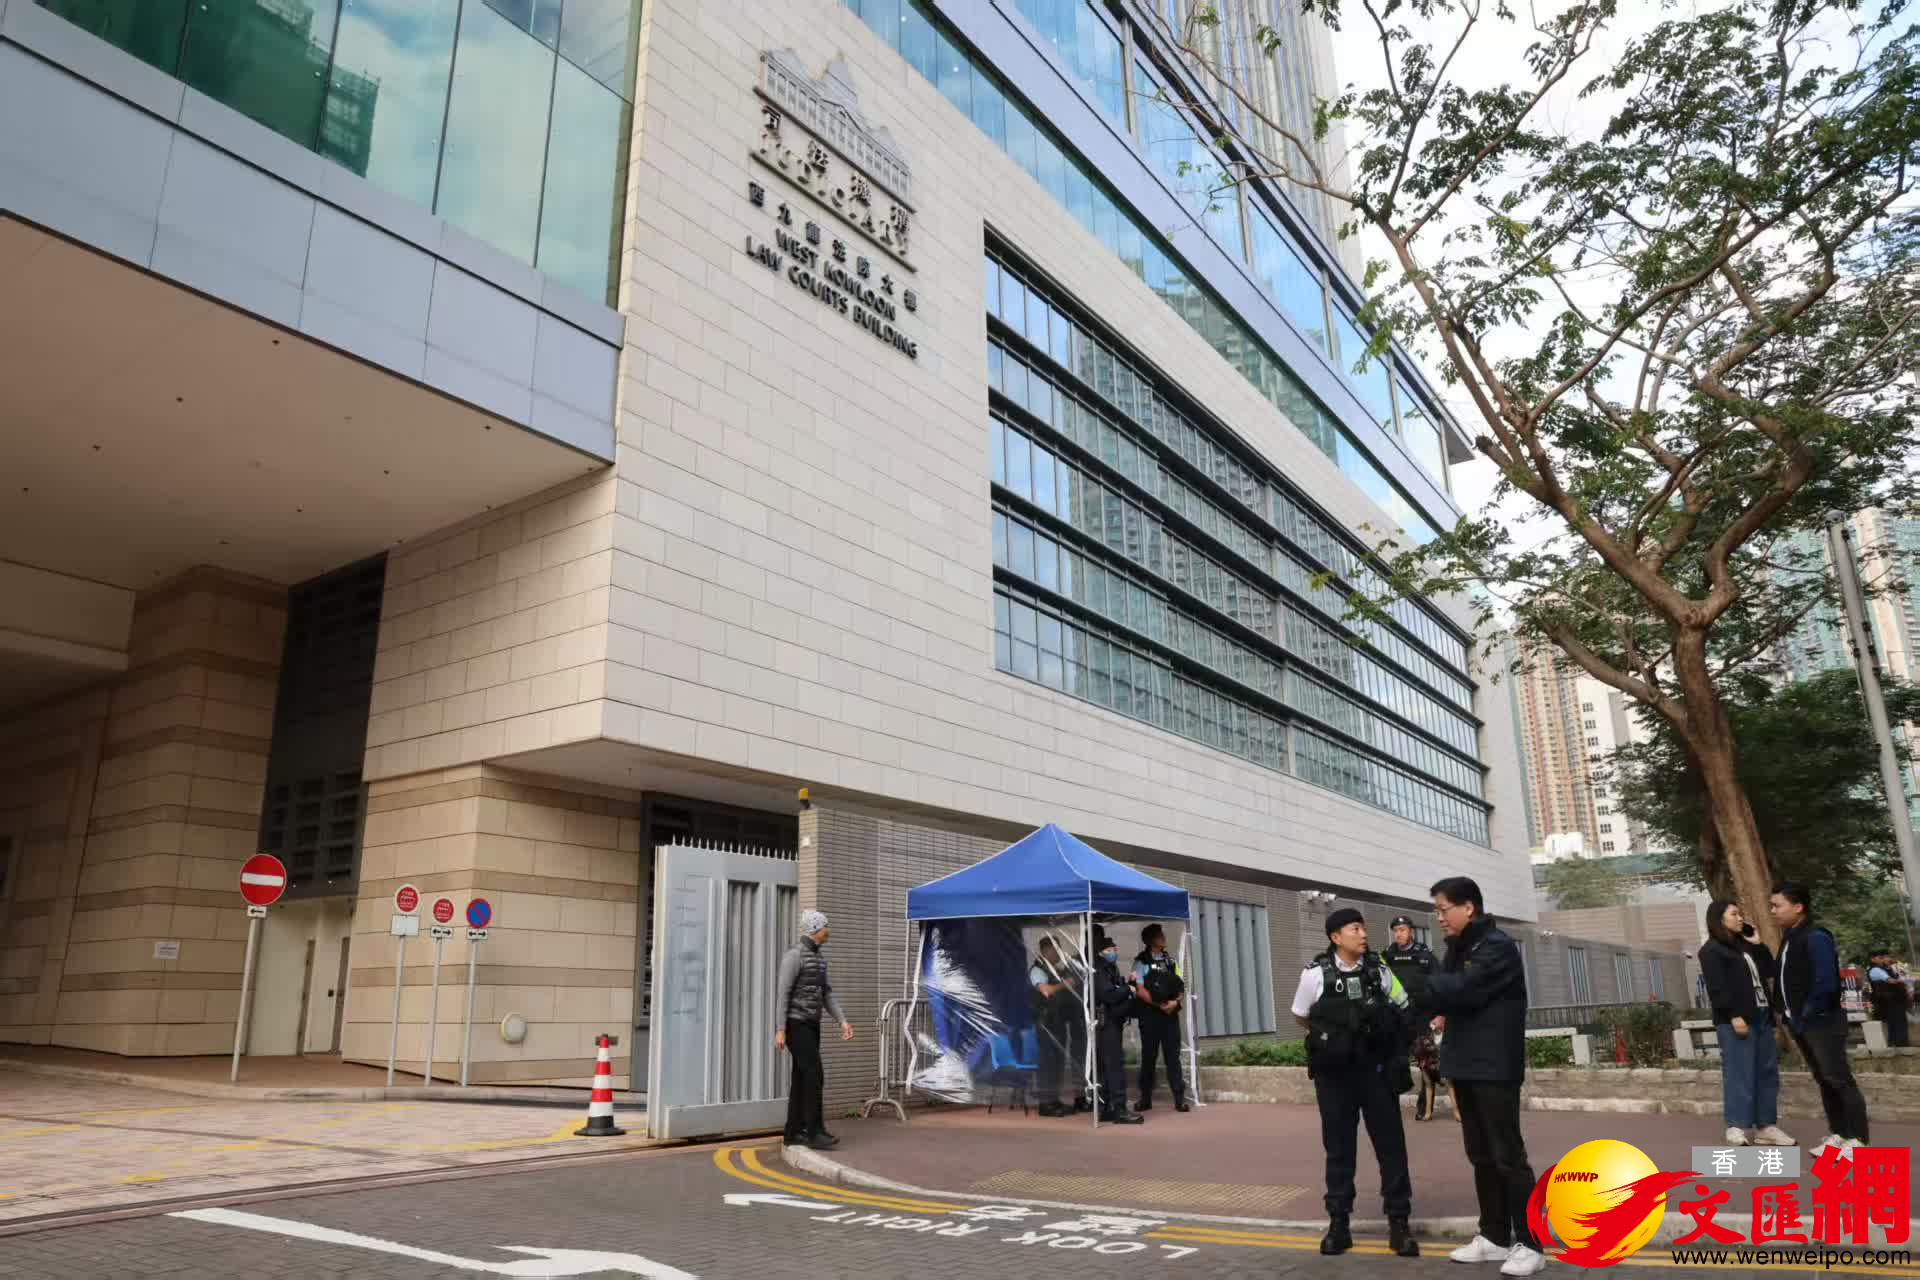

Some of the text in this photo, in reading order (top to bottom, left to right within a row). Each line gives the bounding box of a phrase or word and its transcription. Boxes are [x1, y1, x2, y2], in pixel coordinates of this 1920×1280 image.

[746, 235, 917, 360] LAW COURTS BUILDING
[776, 229, 896, 321] WEST KOWLOON
[809, 1211, 1198, 1259] LOOK RIGHT
